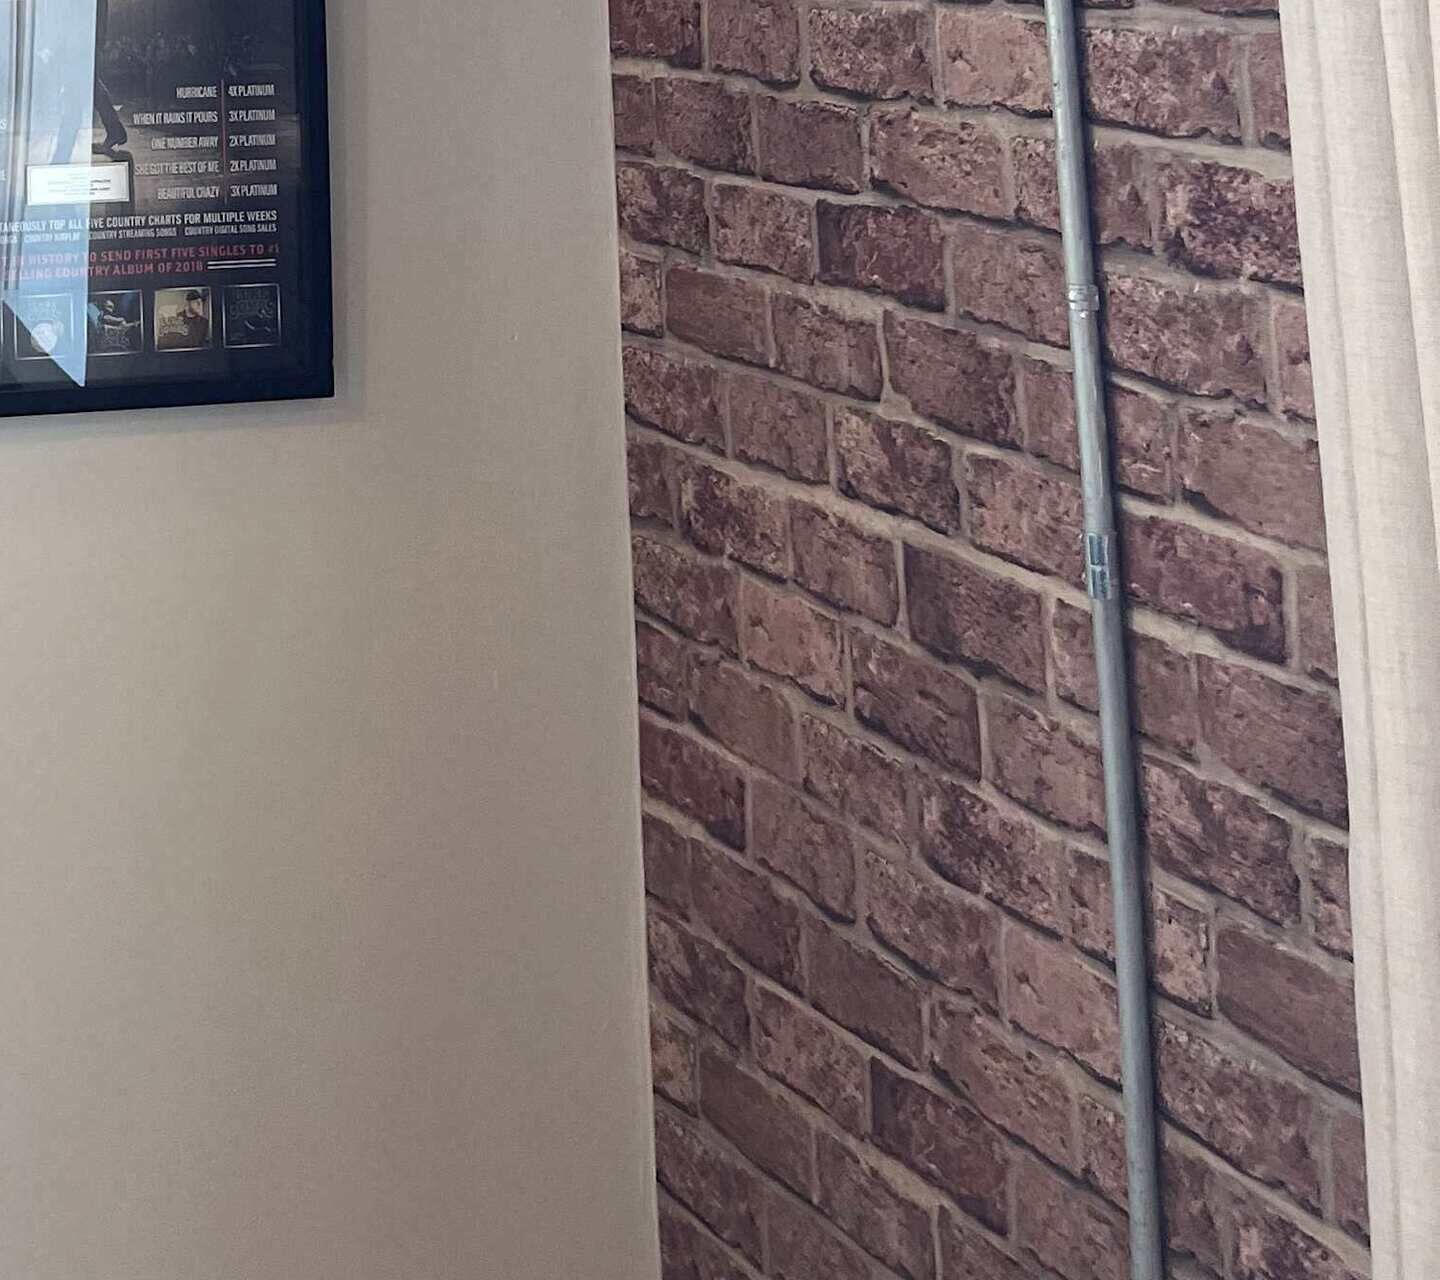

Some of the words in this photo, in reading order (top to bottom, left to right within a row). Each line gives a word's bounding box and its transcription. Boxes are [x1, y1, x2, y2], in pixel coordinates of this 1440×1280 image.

[106, 216, 147, 229] COUNTRY
[148, 214, 182, 226] CHARTS
[184, 213, 202, 225] FOR
[203, 211, 245, 224] MULTIPLE
[246, 210, 278, 222] WEEKS
[100, 250, 132, 263] SEND
[134, 248, 167, 261] FIRST
[171, 246, 195, 258] FIVE
[198, 244, 246, 258] SINGLES
[249, 243, 265, 255] TO
[112, 262, 154, 276] ALBUM
[157, 262, 175, 274] OF
